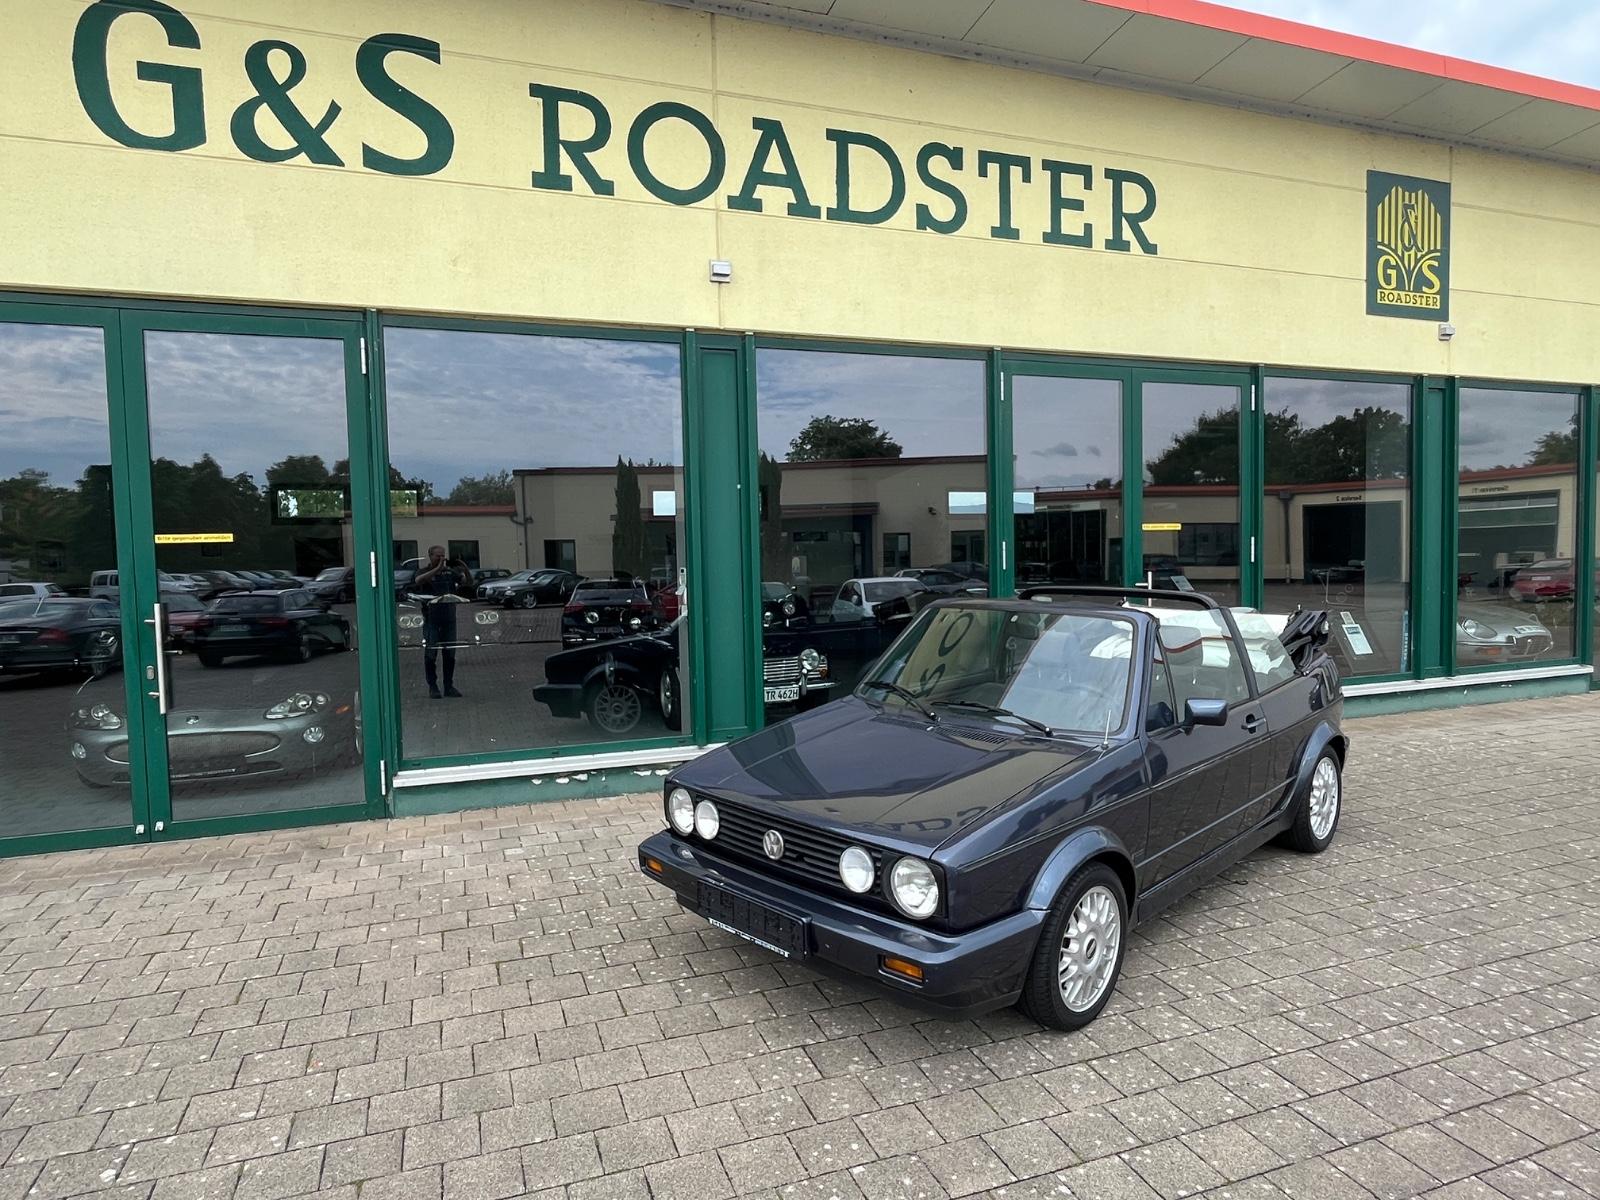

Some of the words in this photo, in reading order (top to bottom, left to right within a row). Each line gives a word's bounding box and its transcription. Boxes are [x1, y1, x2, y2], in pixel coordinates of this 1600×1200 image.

[72, 0, 455, 177] G&S
[529, 83, 1158, 255] ROADSTER
[1379, 291, 1439, 308] ROADSTER
[778, 689, 798, 700] 462H
